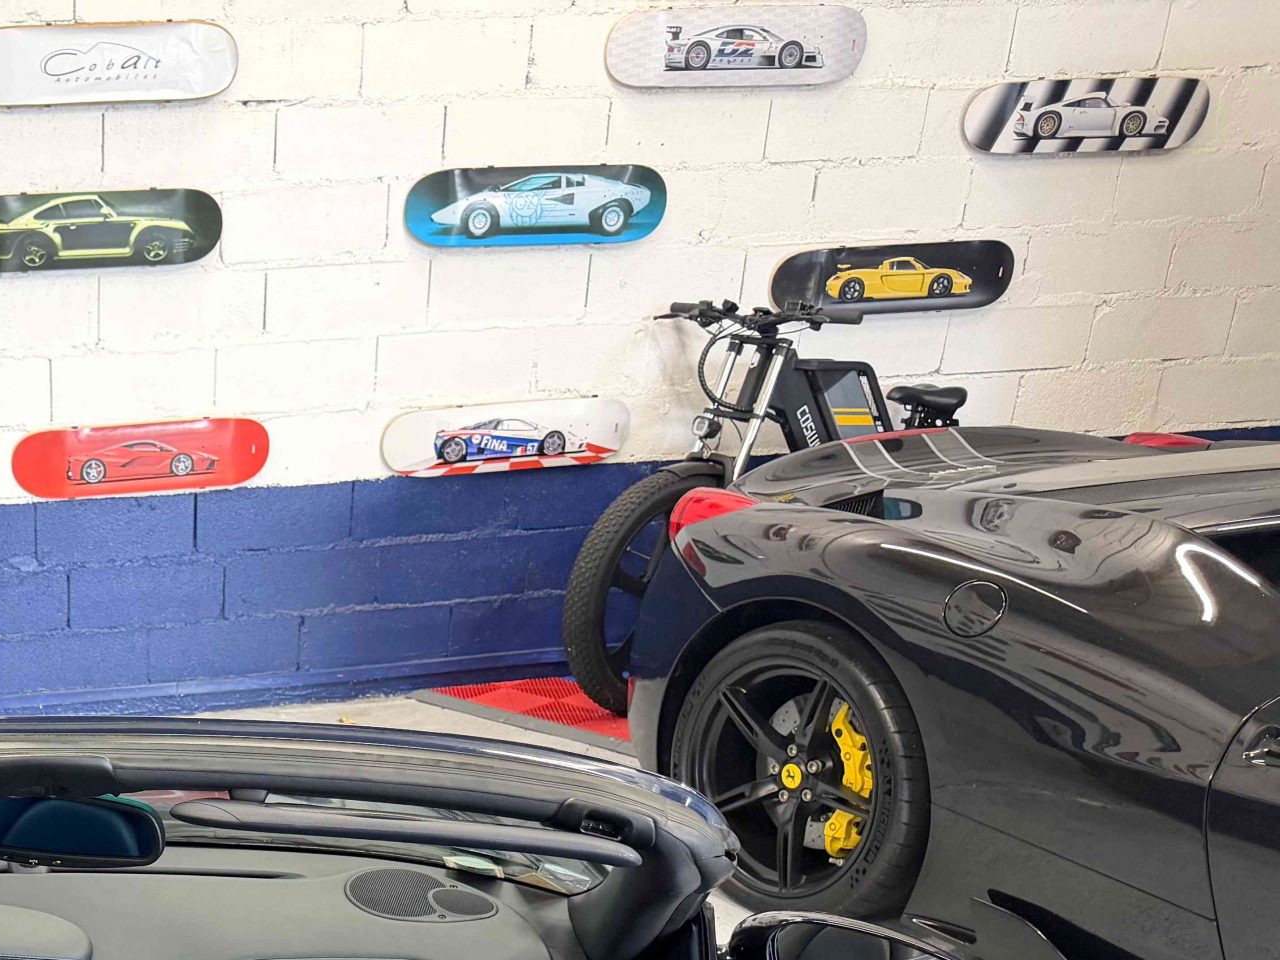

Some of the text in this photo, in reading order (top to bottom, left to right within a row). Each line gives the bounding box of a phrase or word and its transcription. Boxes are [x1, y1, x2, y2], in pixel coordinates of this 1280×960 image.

[43, 52, 162, 77] Cobalt
[796, 404, 821, 448] COSW
[480, 434, 508, 452] FINA
[526, 442, 538, 455] 57
